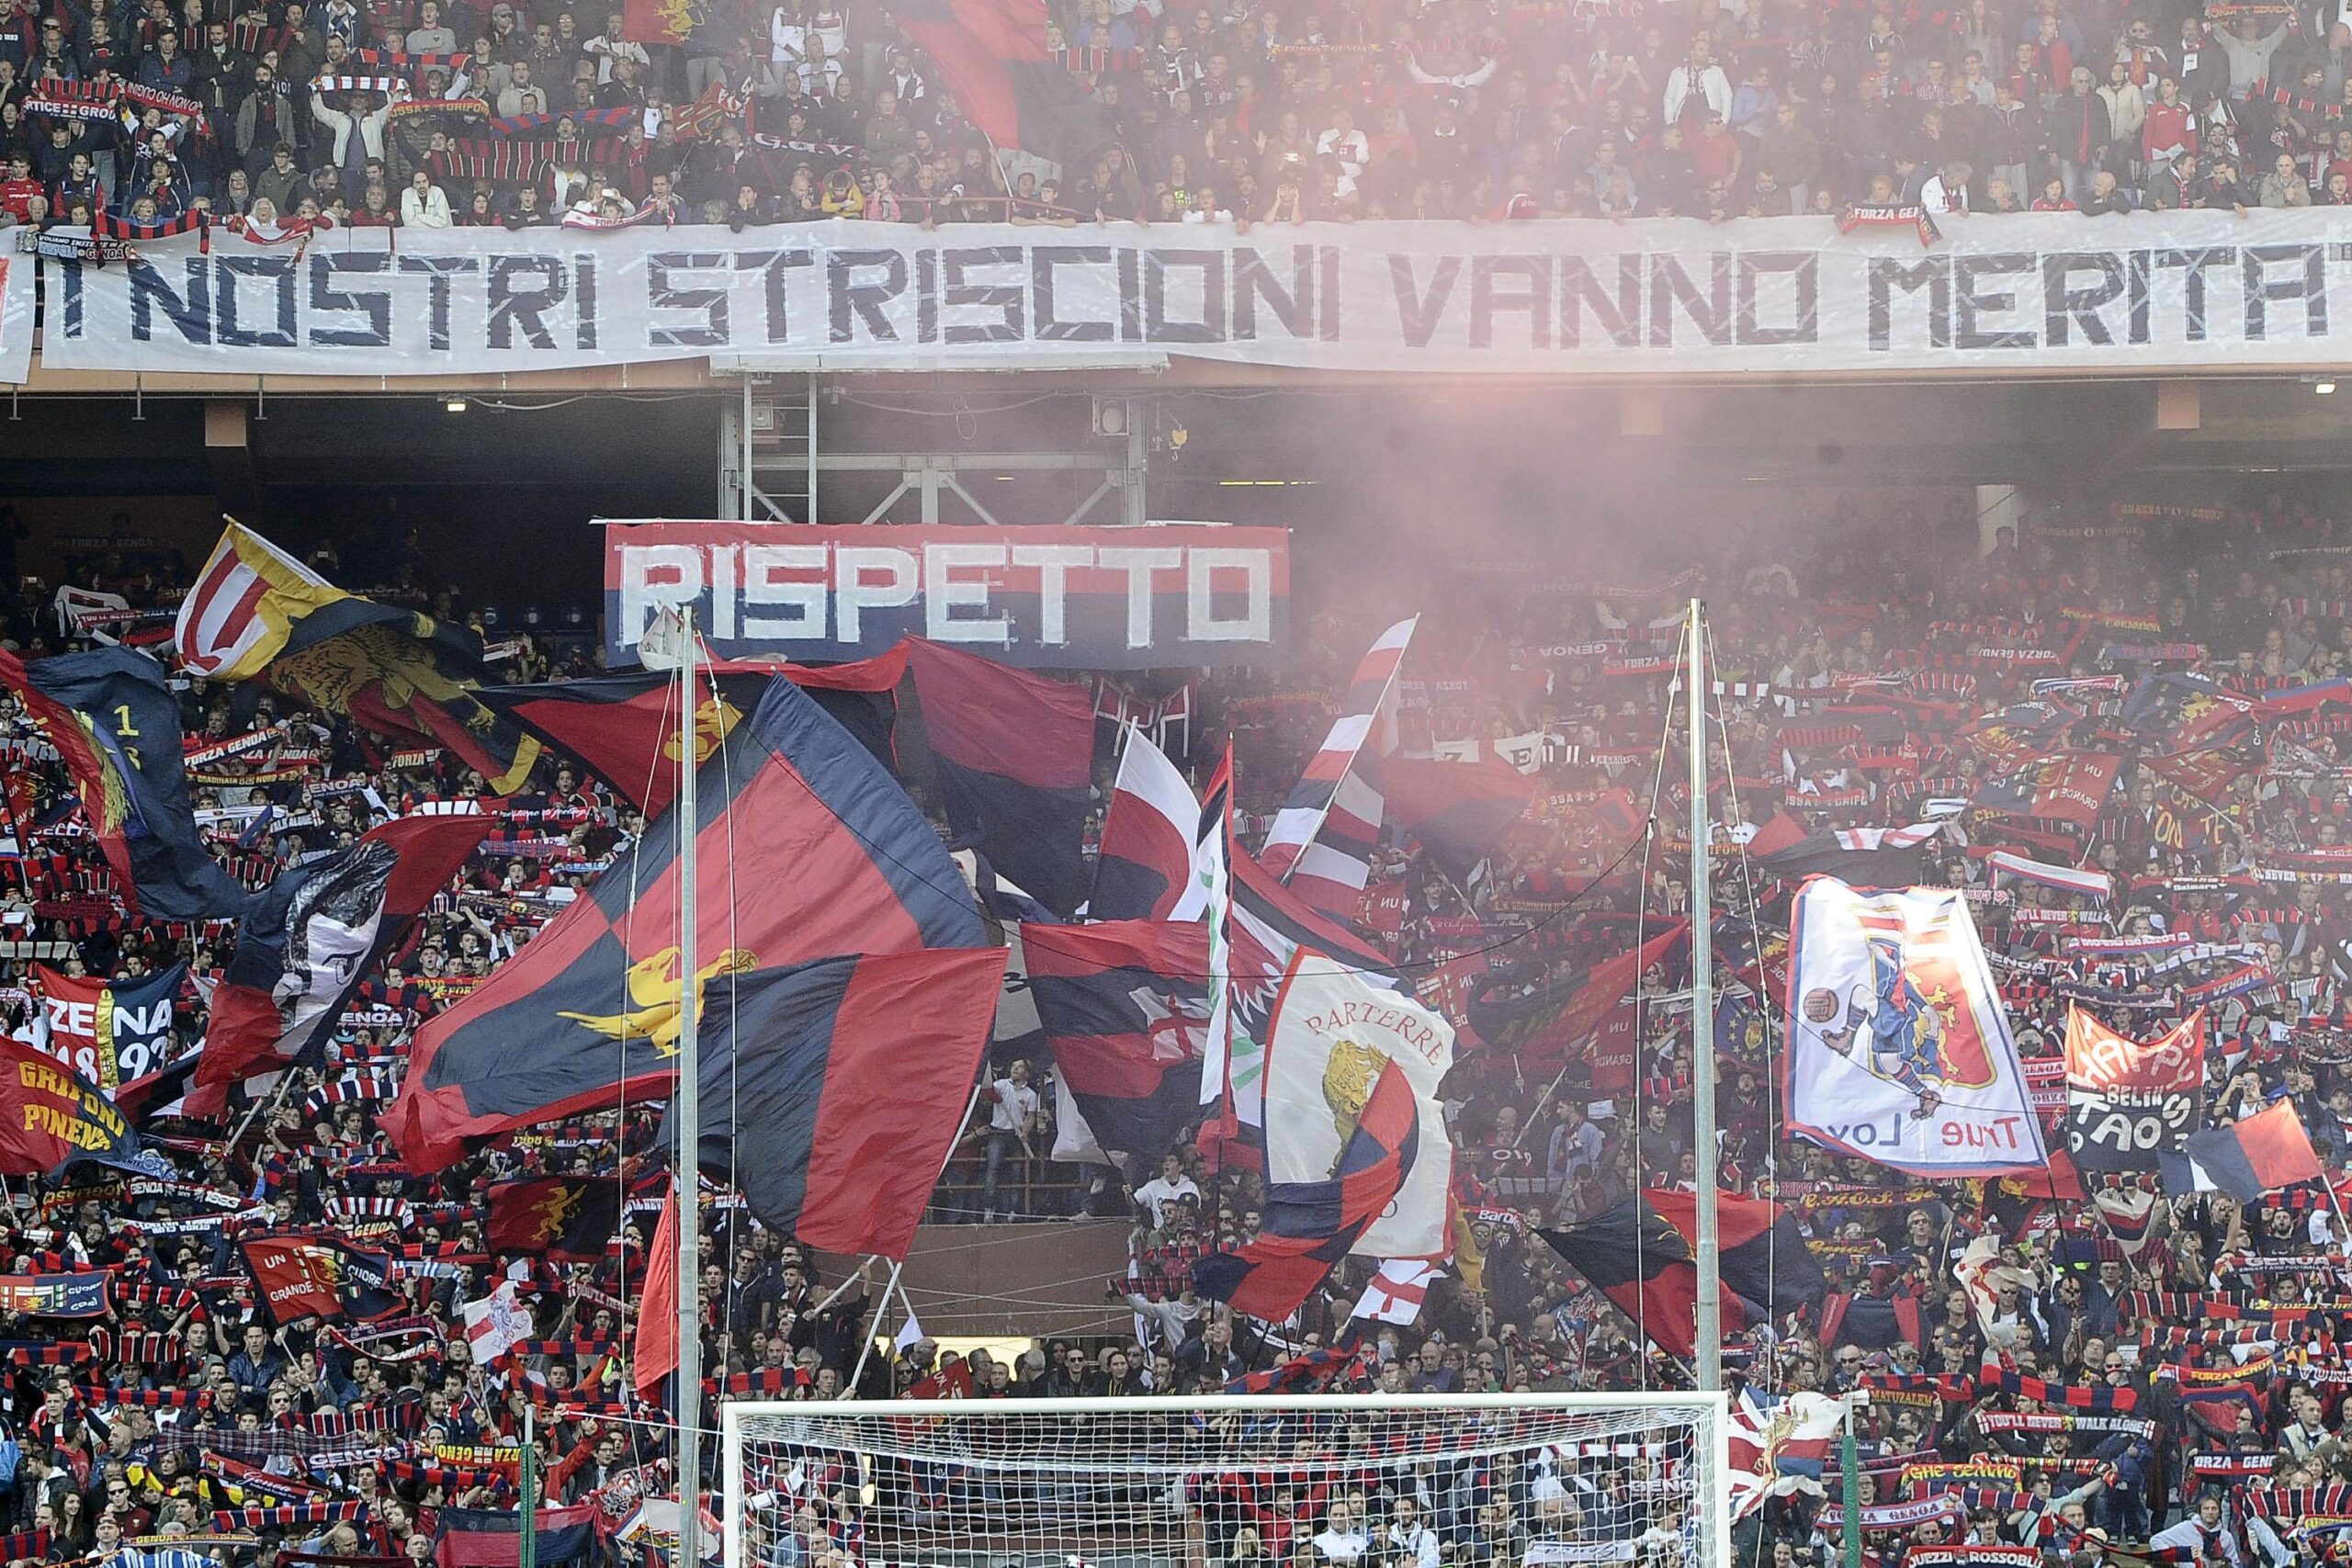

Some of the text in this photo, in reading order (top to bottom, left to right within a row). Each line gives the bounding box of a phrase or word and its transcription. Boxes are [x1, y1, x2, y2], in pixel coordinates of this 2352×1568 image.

[25, 98, 62, 114] RTICE
[1854, 208, 1894, 220] FORZA
[86, 246, 125, 260] GNOA
[63, 257, 84, 339] I
[130, 252, 598, 351] NOSTRI
[648, 244, 1340, 348] STRISCIONI
[1385, 250, 1818, 349] VANNO
[620, 545, 1272, 647] RISPETTO
[1539, 643, 1608, 658] GENOA
[1623, 656, 1661, 669] FORZA
[184, 729, 268, 768] FORZA GENOA
[391, 751, 424, 768] FORZA
[309, 779, 363, 795] ENOA
[340, 1011, 403, 1023] ENOA
[1303, 1001, 1445, 1066] PARTERRE
[130, 1180, 164, 1195] GENOA
[354, 1220, 398, 1238] GENOA
[264, 1253, 287, 1270] UN
[2245, 1256, 2331, 1267] GENOA
[347, 1263, 384, 1289] CUORE
[269, 1280, 314, 1303] GRANDE
[2191, 1359, 2274, 1382] FORZA GENOA
[1986, 1413, 2144, 1434] YOU'LL NEVER WALK ALONE
[1827, 1502, 1939, 1523] FOZA GENOA
[135, 1533, 174, 1544] GENOA
